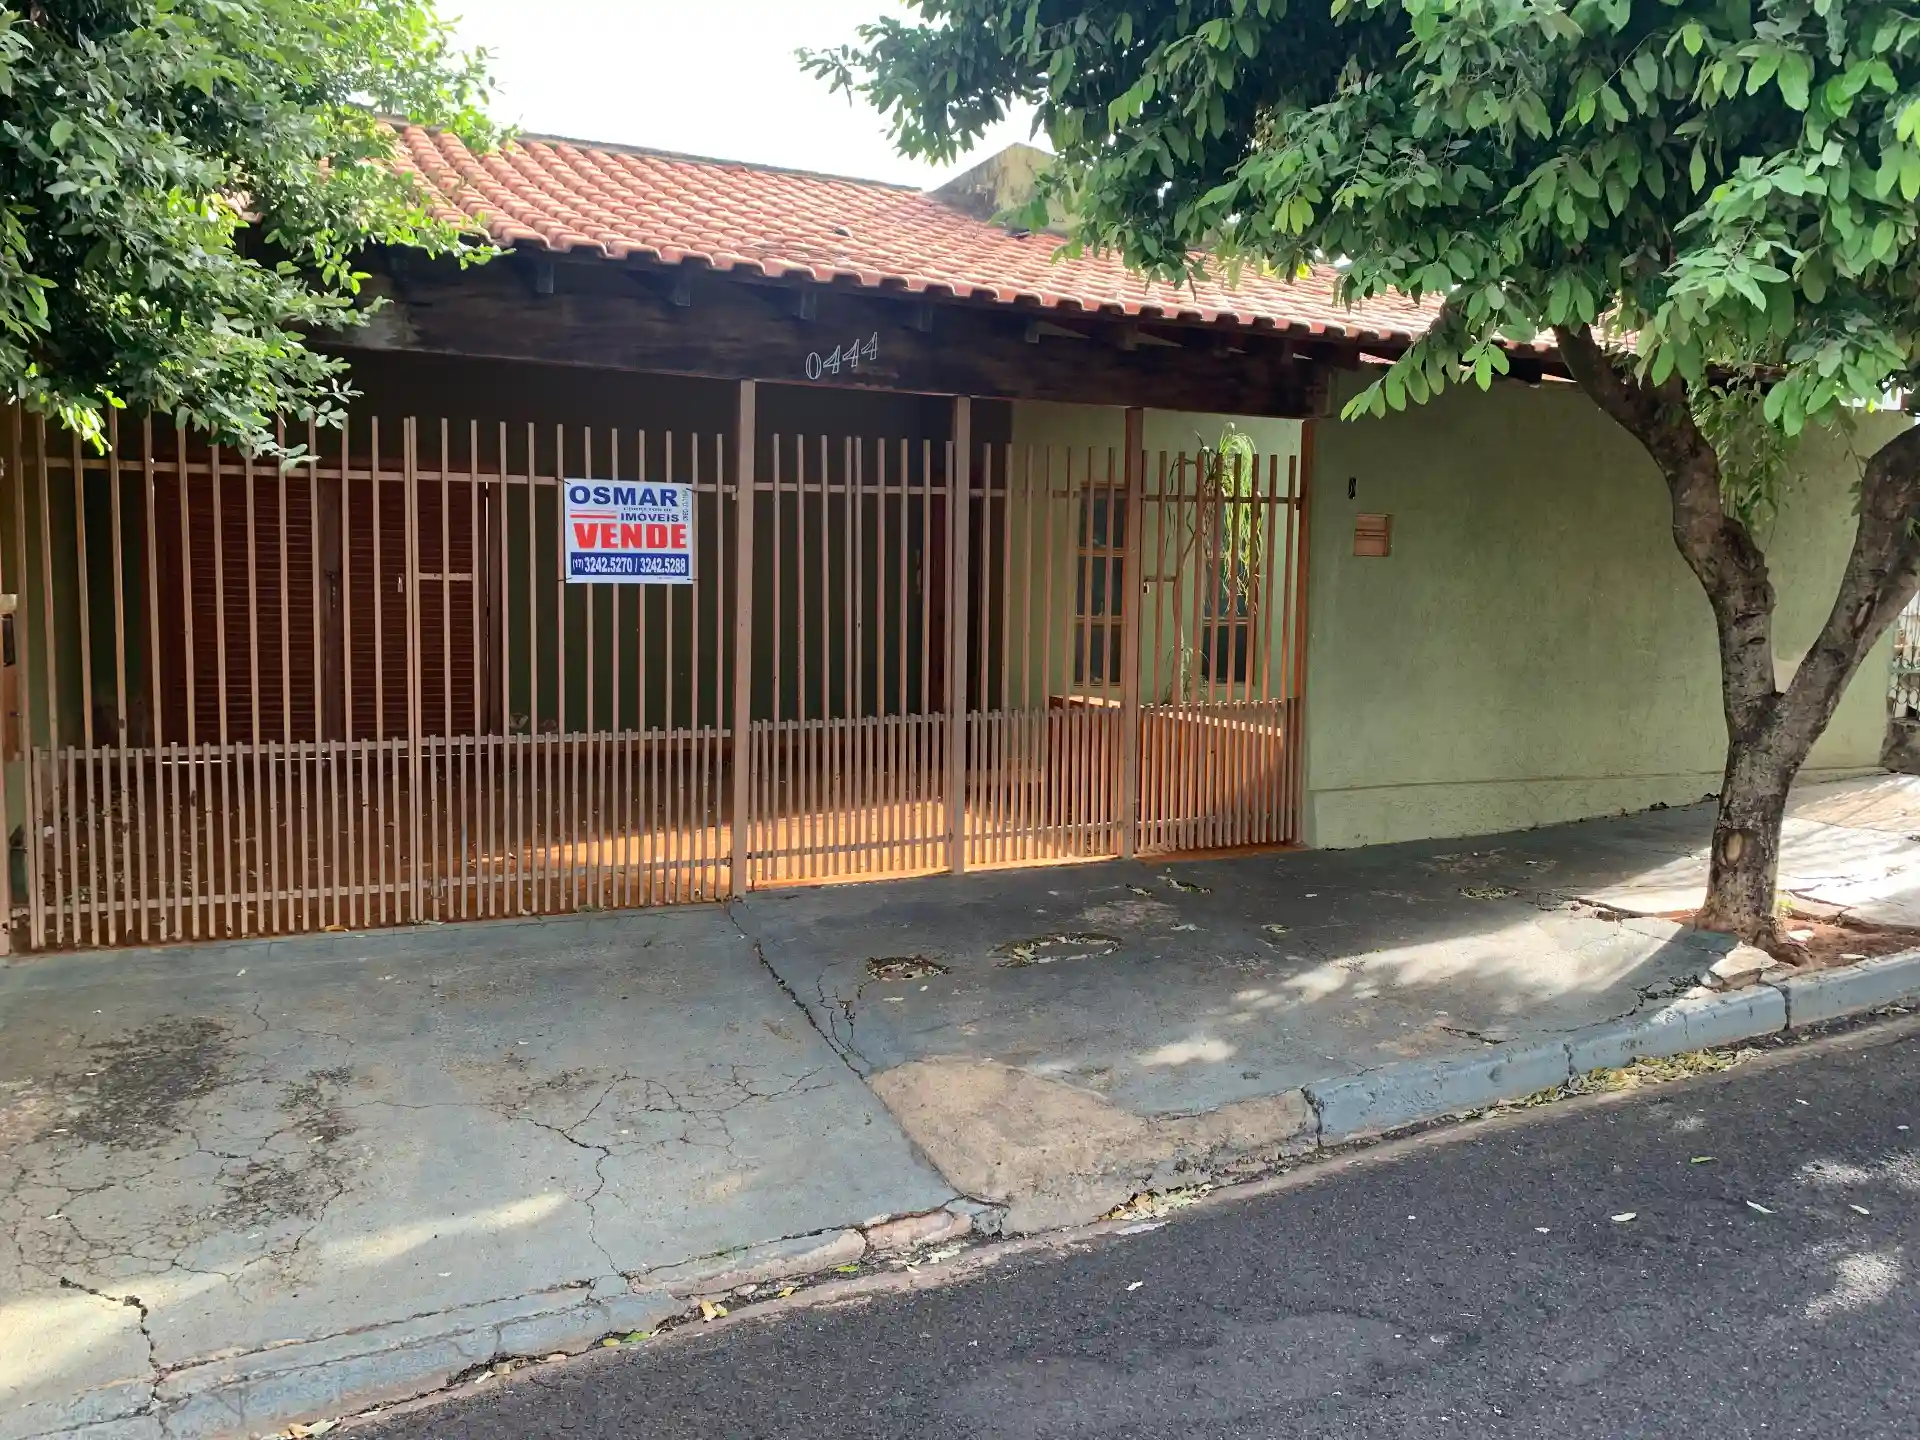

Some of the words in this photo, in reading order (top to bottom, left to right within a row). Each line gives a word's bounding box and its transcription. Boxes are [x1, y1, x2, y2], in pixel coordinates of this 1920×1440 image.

[805, 331, 878, 380] 0444
[569, 485, 679, 507] OSMAR
[573, 522, 687, 549] VENDE
[572, 558, 584, 570] (17)
[584, 556, 633, 573] 3242.5270
[640, 557, 686, 574] 3242.5288
